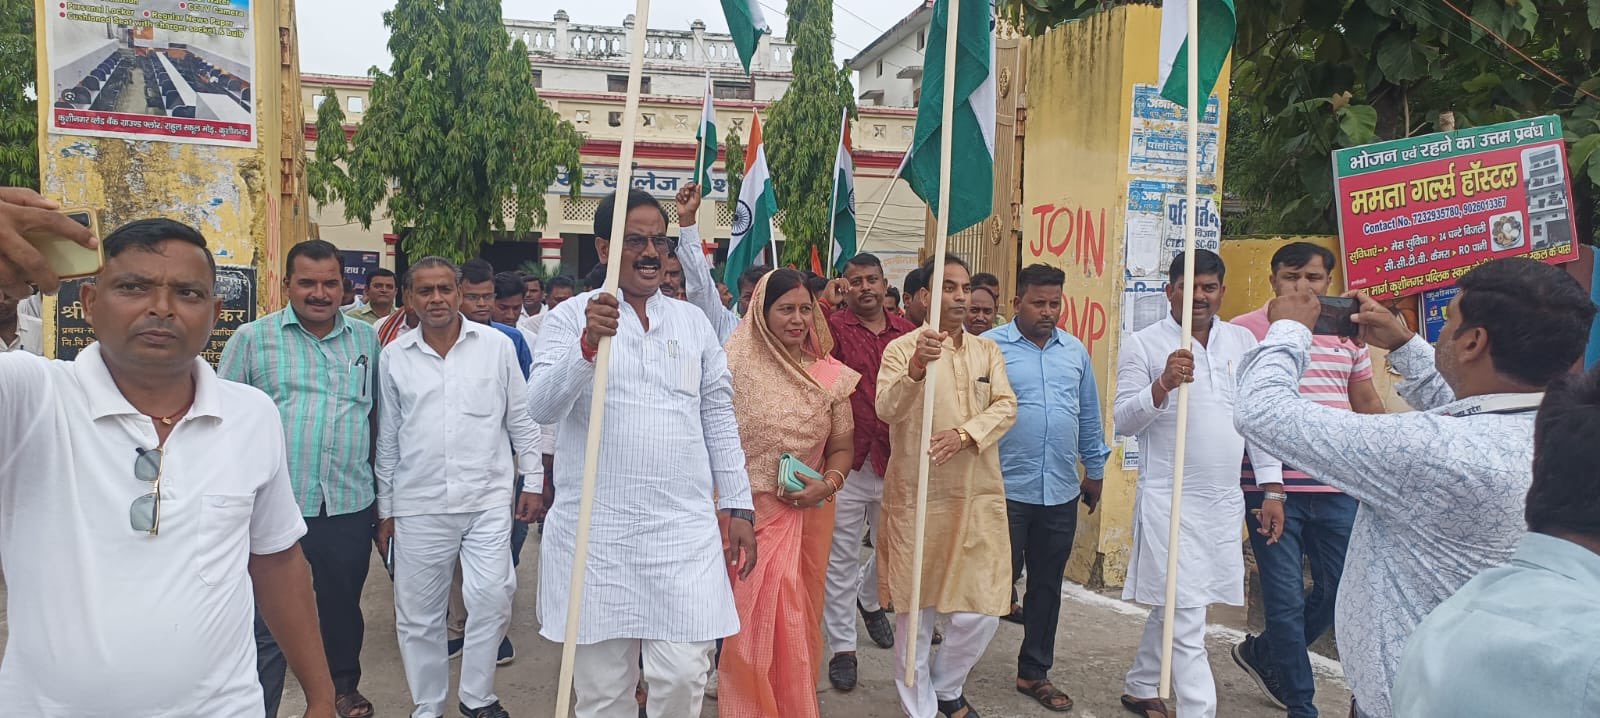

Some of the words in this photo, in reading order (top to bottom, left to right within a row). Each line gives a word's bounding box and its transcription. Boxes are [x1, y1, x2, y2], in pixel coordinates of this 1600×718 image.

[67, 2, 105, 14] Personal
[105, 5, 135, 16] Locker
[152, 10, 184, 21] Regular
[185, 14, 209, 24] News
[210, 17, 234, 27] Paper
[213, 6, 245, 17] Camera
[67, 12, 112, 24] Cushioned
[113, 16, 133, 26] Seat
[133, 19, 153, 27] with
[154, 21, 187, 33] charger
[188, 25, 217, 35] socket
[226, 29, 245, 38] bulb
[58, 113, 89, 125] कुशीनगर
[164, 122, 182, 133] राहुल
[184, 124, 200, 135] स्कूल
[219, 126, 249, 137] कुशीनगर
[1350, 150, 1398, 170] भोजन
[1402, 145, 1418, 161] एवं
[1420, 135, 1453, 157] रहने
[1456, 135, 1476, 151] का
[1479, 129, 1511, 148] उत्तम
[1515, 121, 1544, 144] प्रबंध
[1350, 182, 1407, 215] ममता
[1410, 162, 1456, 202] गर्ल्स
[1460, 160, 1518, 197] हॉस्टल
[1364, 218, 1396, 234] Contact
[1397, 216, 1411, 229] No.
[1463, 196, 1507, 215] 9026013367
[1030, 203, 1105, 278] JOIN
[1439, 232, 1447, 241] 24
[1463, 220, 1487, 236] बिजली
[1459, 244, 1470, 256] RO
[1472, 239, 1488, 252] पानी
[1557, 244, 1571, 255] पास
[1390, 276, 1425, 297] कुशीनगर
[1425, 269, 1450, 283] पब्लिक
[61, 301, 85, 320] श्री
